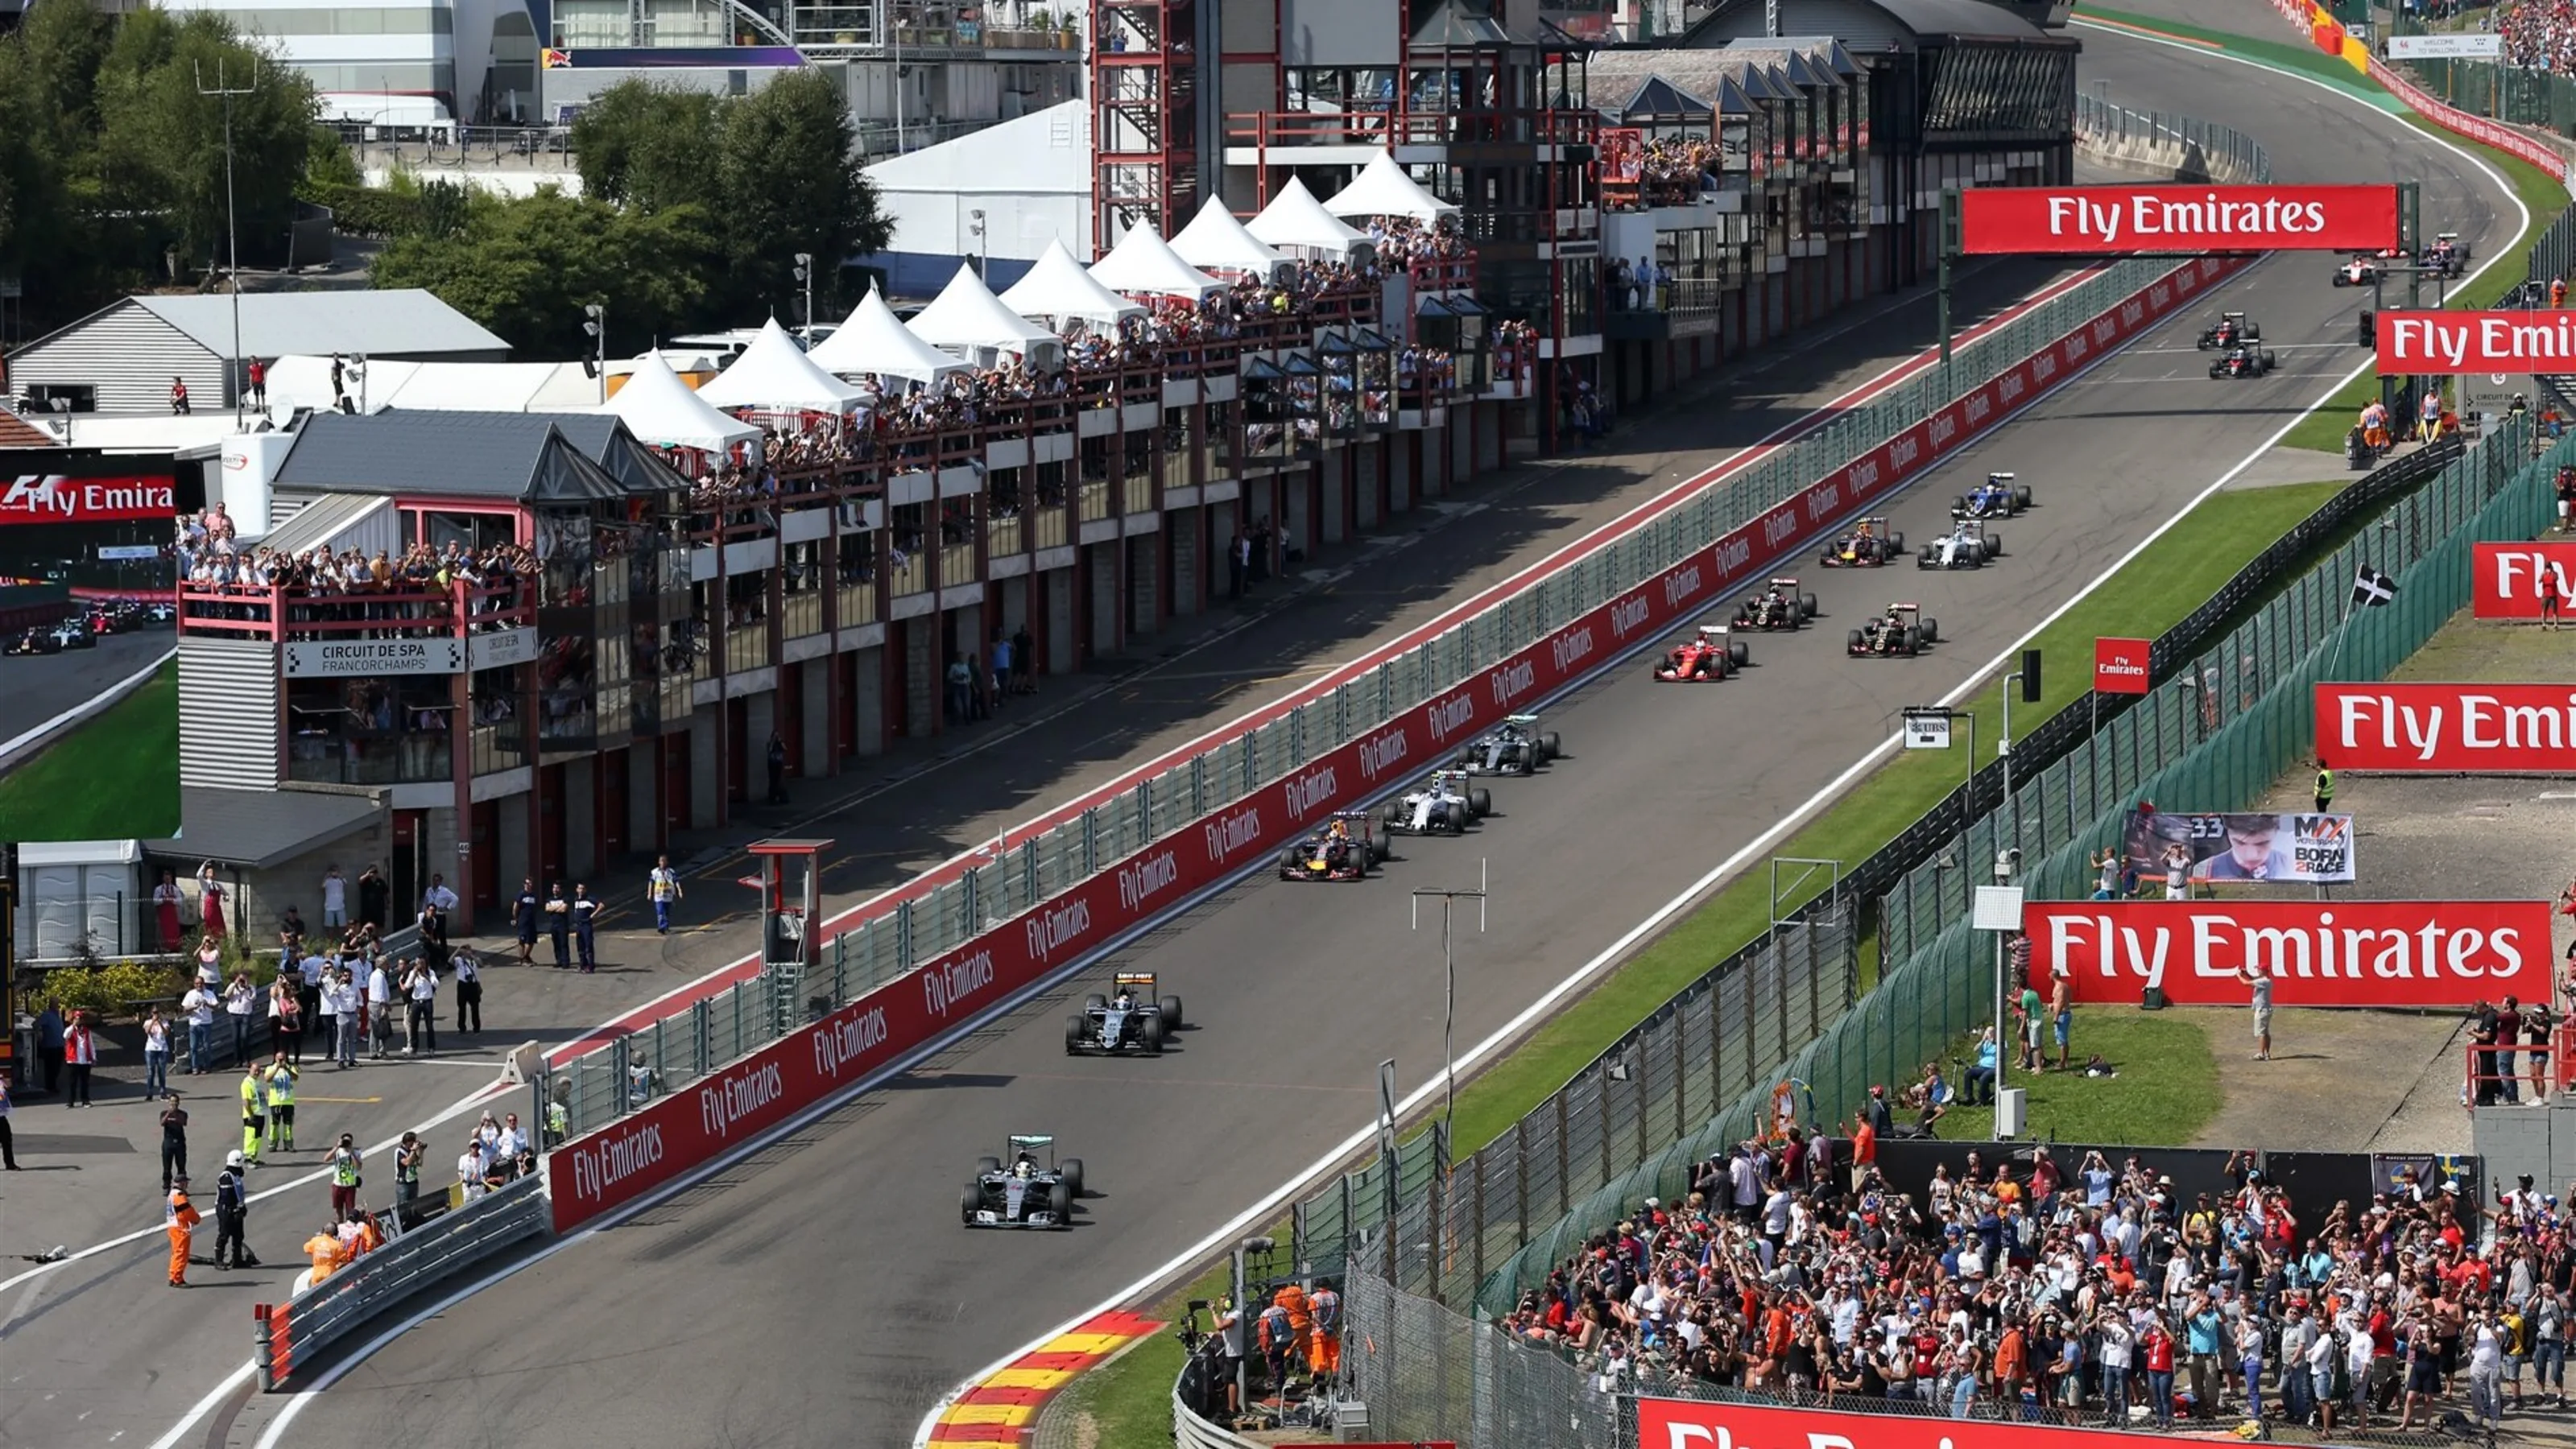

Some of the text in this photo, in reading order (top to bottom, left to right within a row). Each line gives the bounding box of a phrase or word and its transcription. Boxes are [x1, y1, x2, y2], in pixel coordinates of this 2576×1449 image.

[2049, 194, 2325, 242] Fly Emirates
[2392, 316, 2576, 367] Fly Emi
[84, 482, 174, 510] Emira
[322, 644, 425, 659] CIRCUIT DE SPA
[322, 658, 426, 671] FRANCORCHAMPS
[1553, 626, 1592, 673] Fly Emirates
[2099, 663, 2144, 675] Emirates
[2115, 656, 2128, 666] Fly
[1492, 660, 1534, 707] Fly Emirates
[1429, 693, 1473, 742] Fly Emirates
[1923, 723, 1946, 733] UBS
[2338, 695, 2442, 760] Fly
[1360, 729, 1407, 780] Fly Emirates
[1285, 766, 1336, 821] Fly Emirates
[1205, 808, 1259, 864] Fly Emirates
[2189, 817, 2225, 839] 33
[2294, 847, 2345, 862] BORN
[2295, 861, 2346, 873] 2RACE
[1119, 851, 1176, 908] Fly Emirates
[1027, 898, 1090, 962] Fly Emirates
[2047, 911, 2523, 989] Fly Emirates
[924, 950, 993, 1017] Fly Emirates
[813, 1006, 887, 1077] Fly Emirates
[701, 1062, 781, 1137] Fly Emirates
[573, 1124, 662, 1201] Fly Emirates
